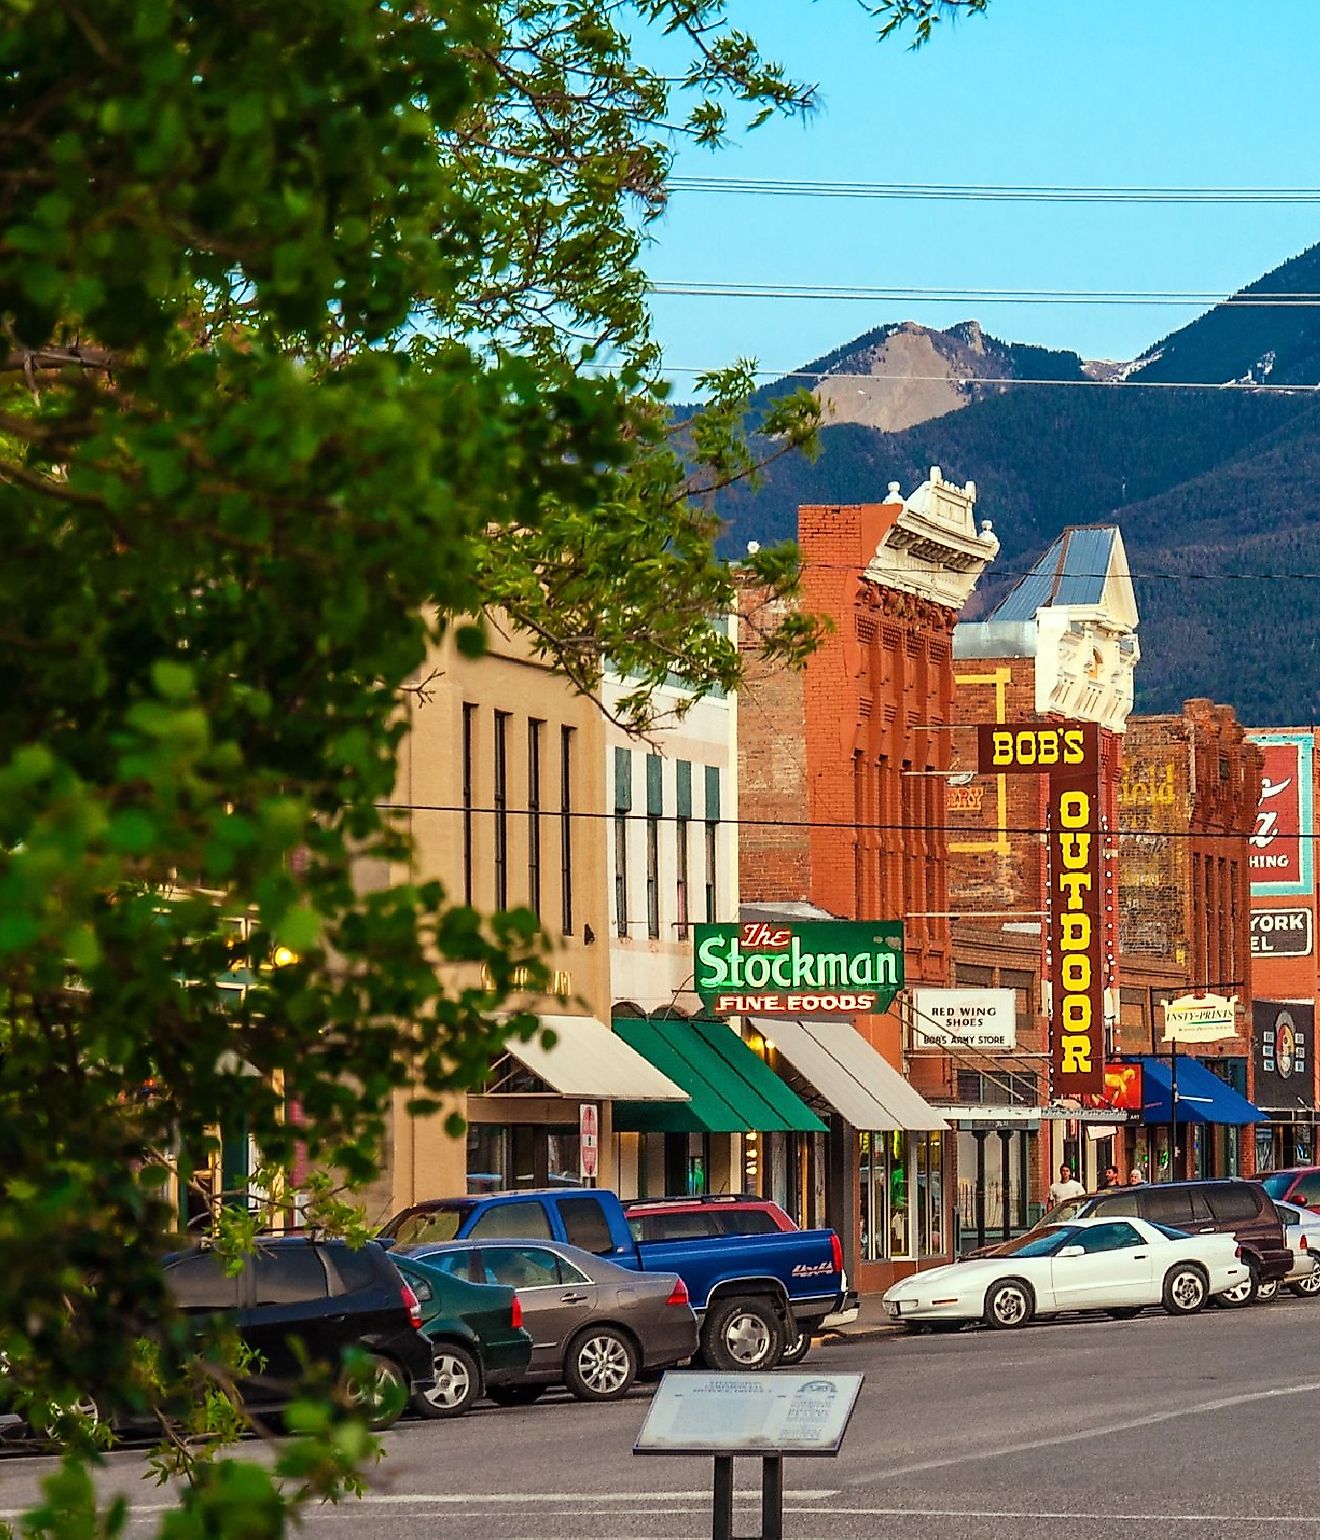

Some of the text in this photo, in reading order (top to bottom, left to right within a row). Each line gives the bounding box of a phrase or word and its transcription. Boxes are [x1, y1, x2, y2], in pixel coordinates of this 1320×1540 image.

[992, 727, 1085, 766] BOB'S
[1249, 854, 1290, 868] HING
[1249, 913, 1304, 933] YORK
[740, 923, 791, 948] The
[1059, 790, 1093, 1075] OUTDOOR
[698, 933, 899, 989] Stockman
[716, 994, 876, 1012] FINE FOODS
[931, 1007, 997, 1017] RED WING
[945, 1018, 984, 1028] SHOES
[1166, 1009, 1234, 1022] INSTY-PRINTS
[951, 1035, 975, 1045] ARMY
[978, 1035, 1005, 1045] STORE
